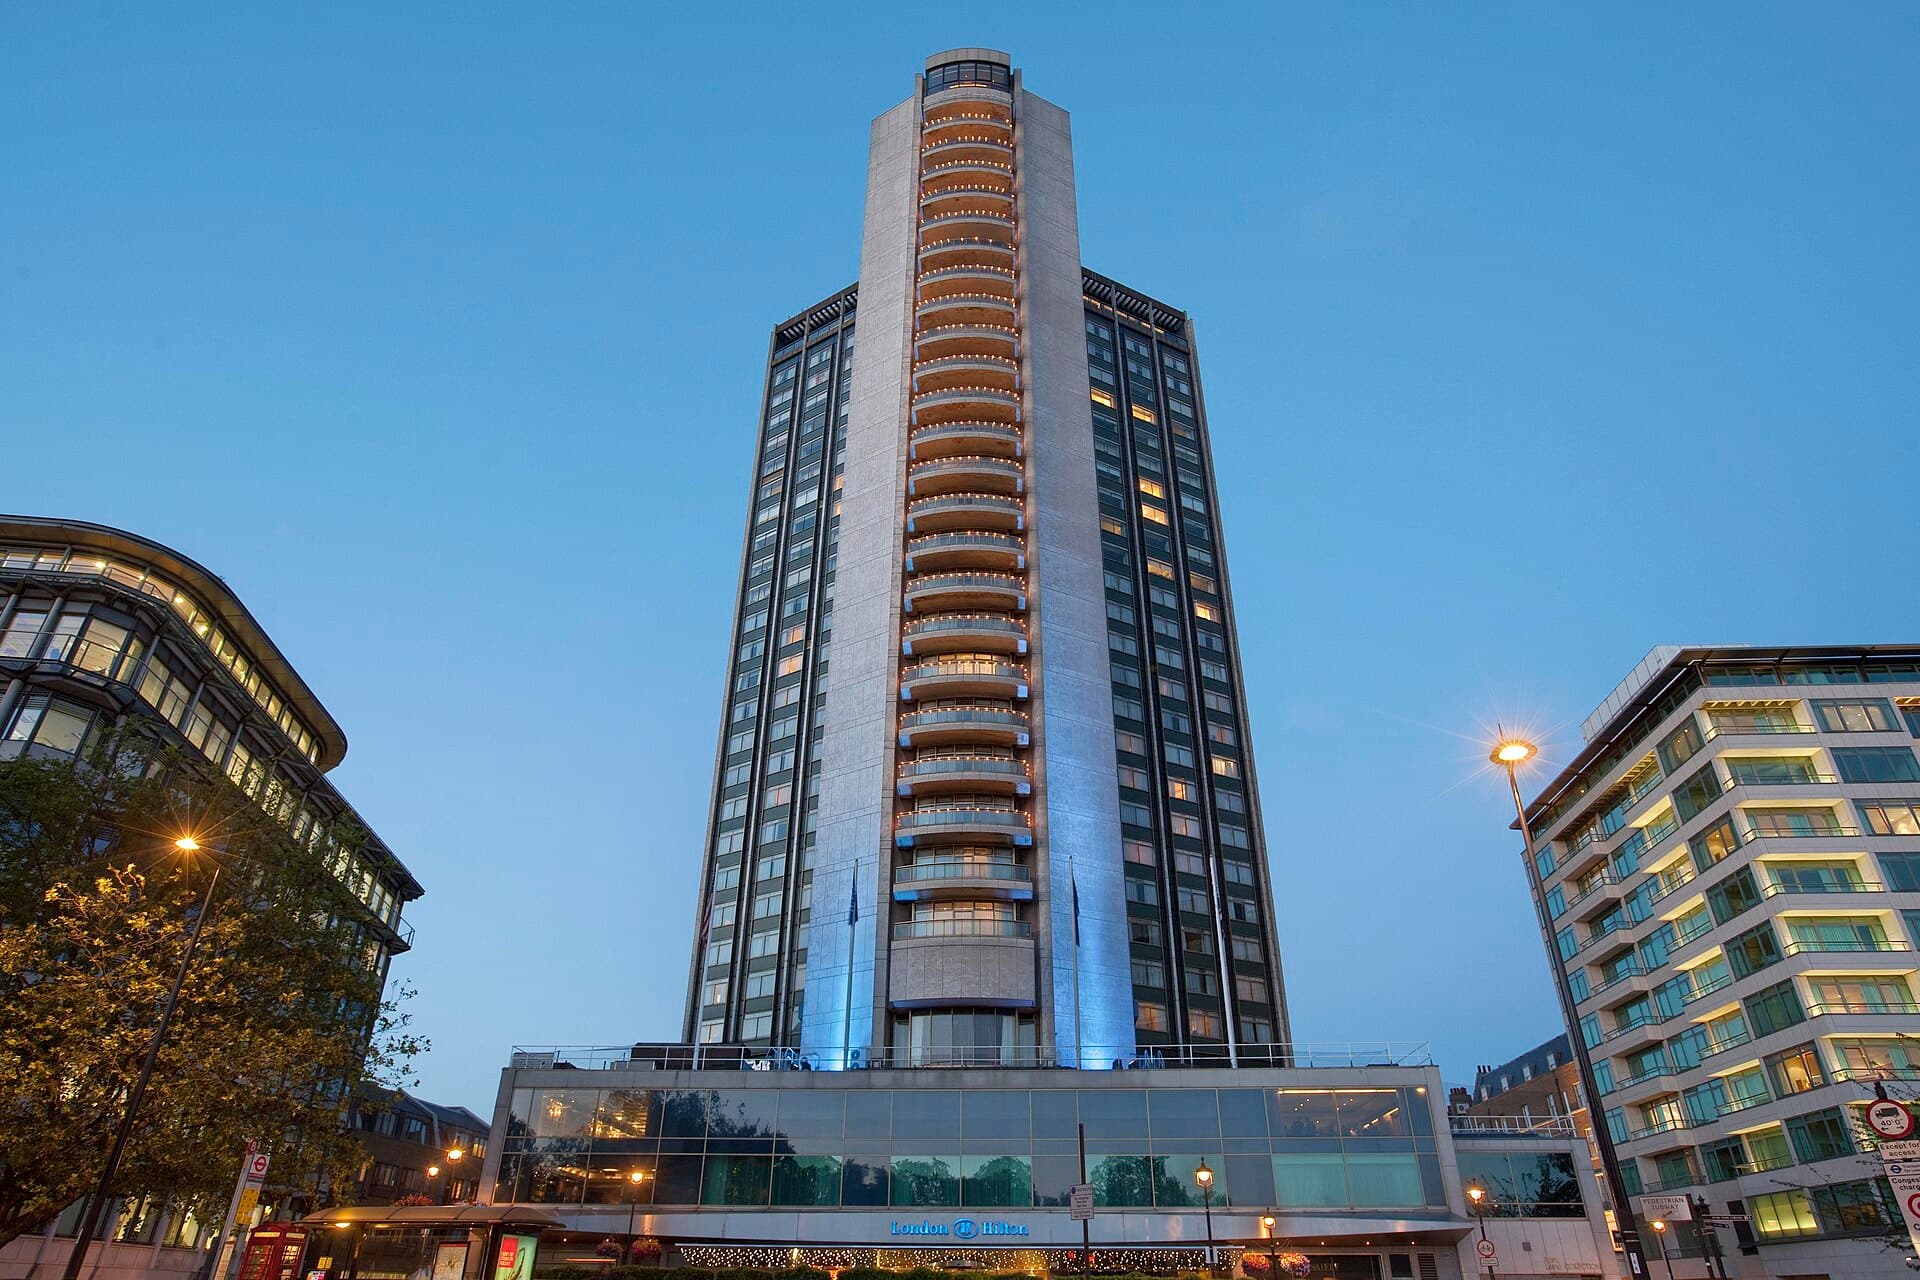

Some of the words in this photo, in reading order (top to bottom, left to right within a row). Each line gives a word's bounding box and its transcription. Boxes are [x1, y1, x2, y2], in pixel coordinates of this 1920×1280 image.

[1909, 1141, 1920, 1149] for
[891, 1220, 949, 1235] London
[982, 1220, 1029, 1235] Hilton
